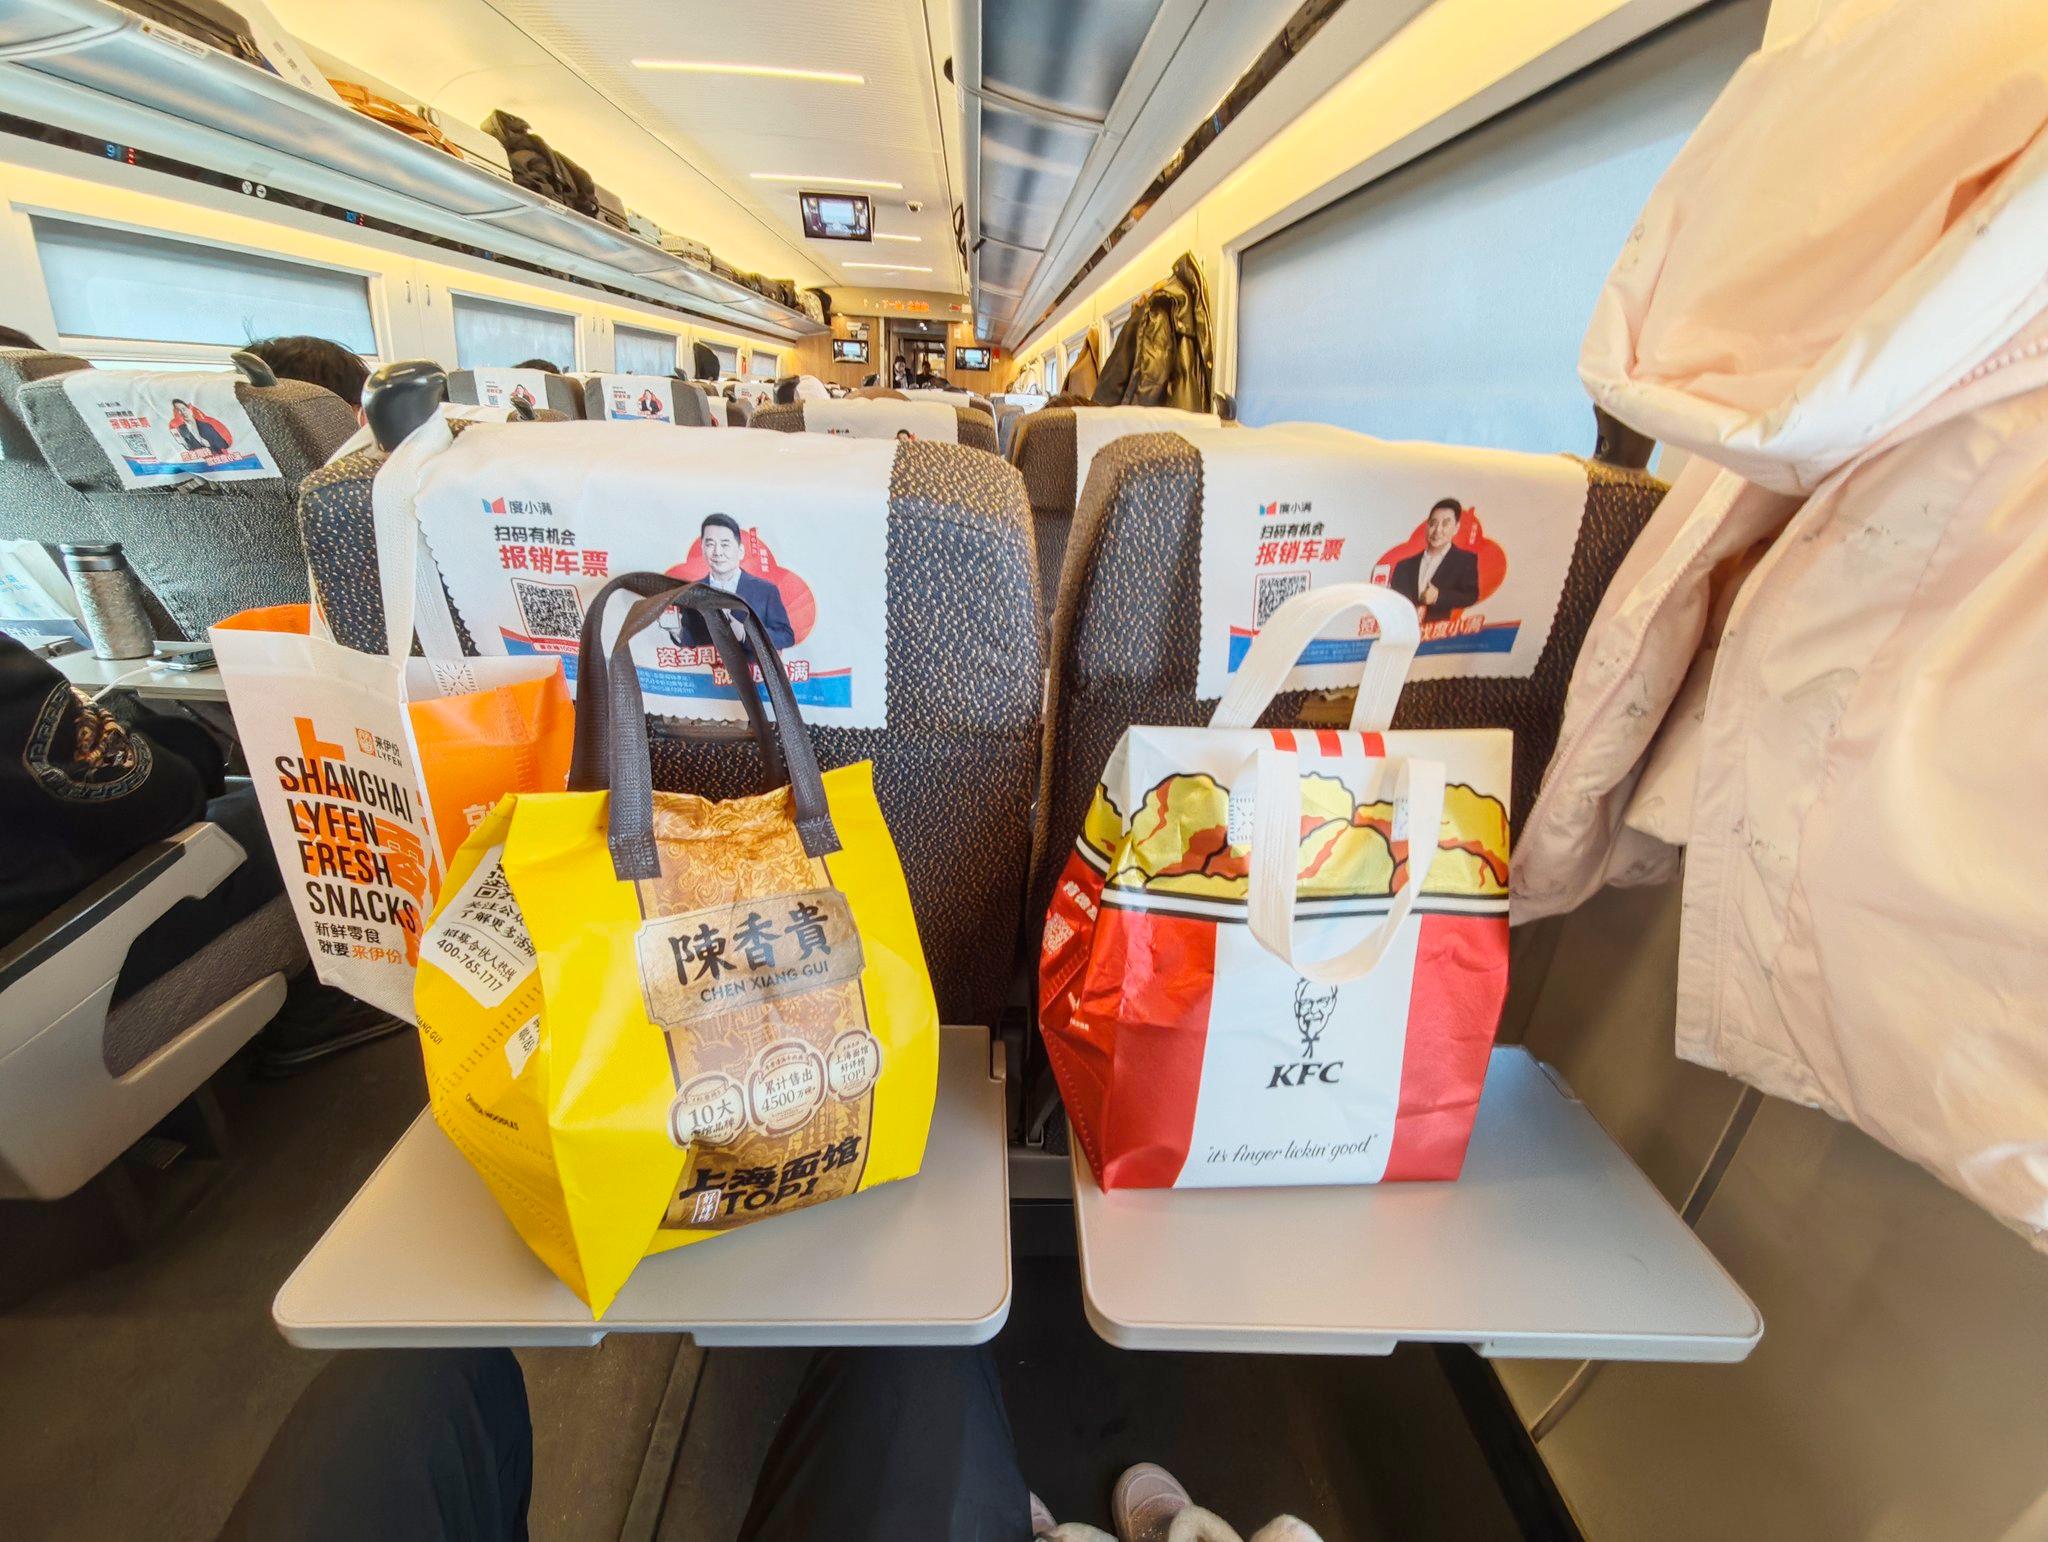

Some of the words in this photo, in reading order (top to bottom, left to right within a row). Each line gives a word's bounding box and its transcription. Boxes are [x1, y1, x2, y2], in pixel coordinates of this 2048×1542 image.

[509, 500, 554, 516] 度小满
[1278, 501, 1313, 514] 度小满
[494, 525, 576, 547] 扫码有机会
[1260, 521, 1325, 540] 扫码有机会
[499, 544, 609, 578] 报销车票
[1255, 537, 1346, 567] 报销车票
[374, 735, 401, 757] 来伊份
[376, 750, 404, 768] LYFEN
[274, 756, 414, 824] SHANGHAI
[287, 798, 380, 847] LYFEN
[297, 839, 393, 888] FRESH
[306, 881, 416, 935] SNACKS
[314, 921, 382, 945] 新鲜零食
[668, 902, 835, 988] 陳香貴
[437, 939, 504, 992] 400-765-1717
[701, 980, 747, 1004] CHEN
[750, 967, 799, 992] XIANG
[802, 961, 829, 979] GUI
[764, 1068, 813, 1096] 累计售出
[1266, 1061, 1345, 1090] KFC
[678, 1135, 863, 1201] 上海面馆
[1232, 1144, 1283, 1167] finger
